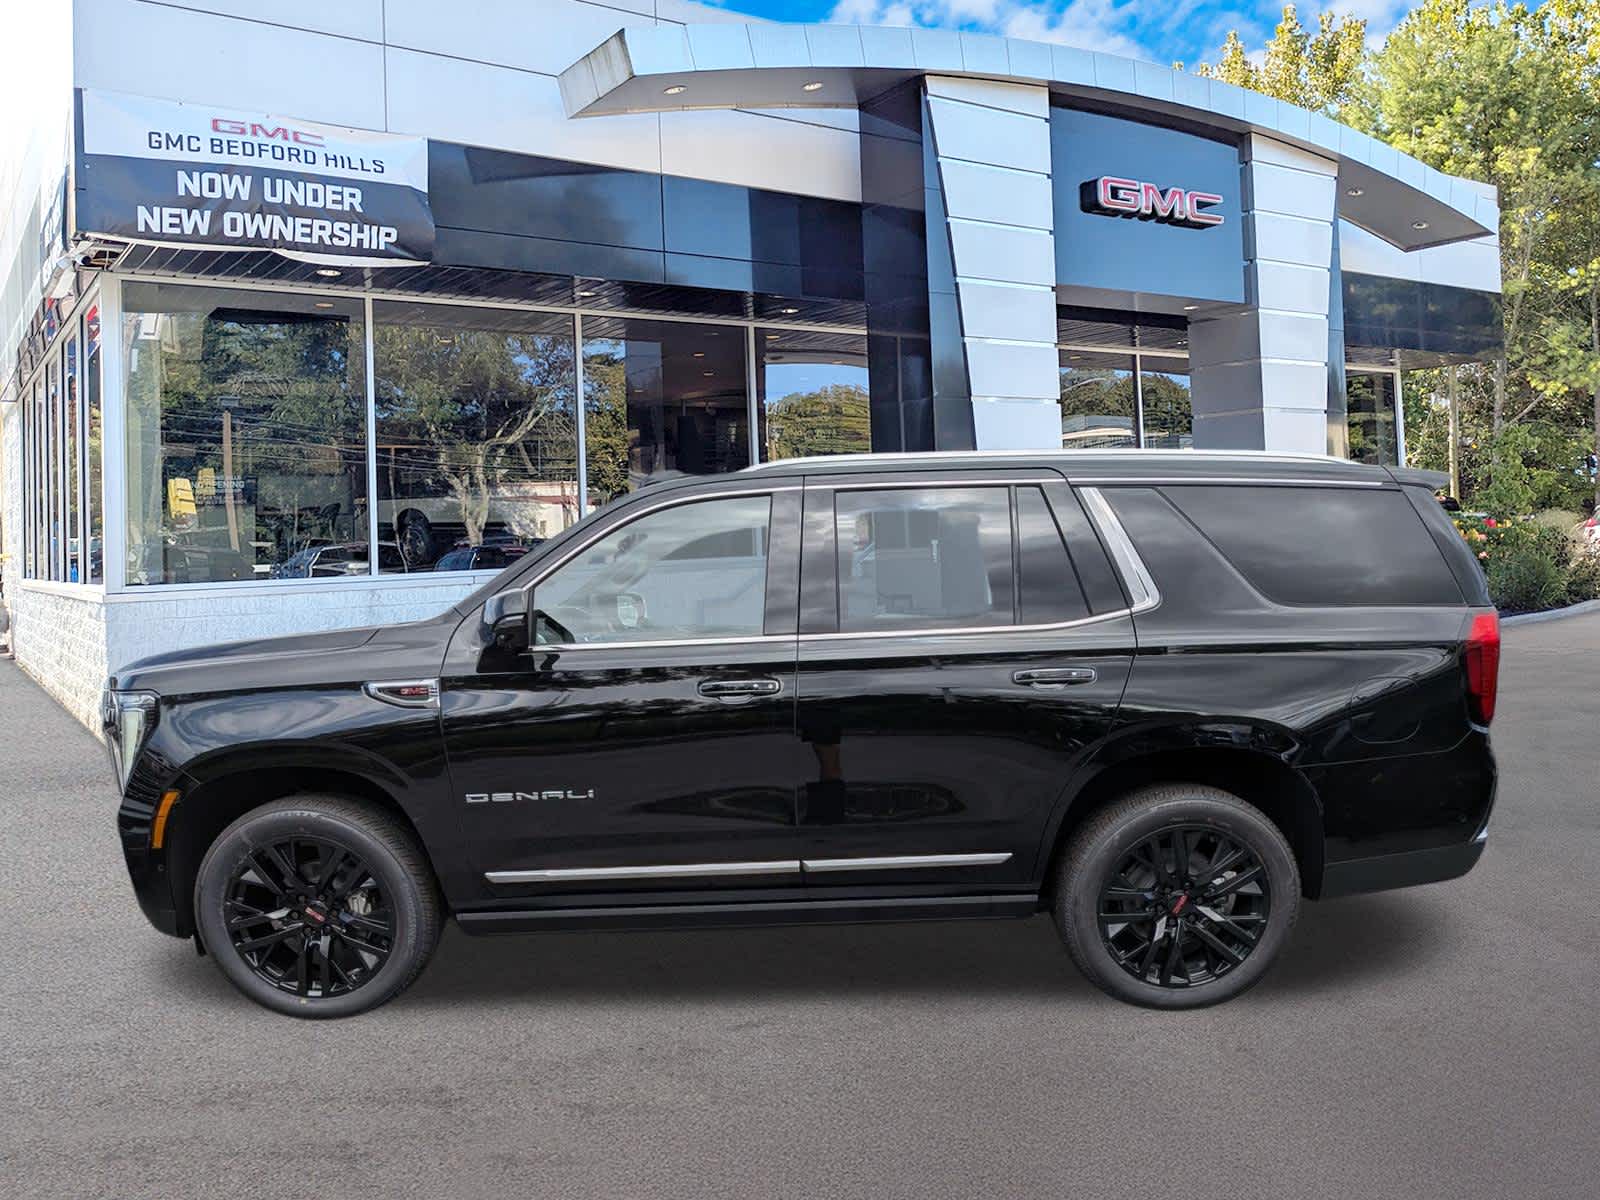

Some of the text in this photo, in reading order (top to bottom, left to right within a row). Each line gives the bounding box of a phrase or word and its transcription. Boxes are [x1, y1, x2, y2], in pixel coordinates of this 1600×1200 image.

[148, 131, 386, 174] GMC BEDFORD HILLS
[211, 118, 325, 148] GMC
[176, 170, 364, 213] NOW UNDER
[1097, 175, 1225, 225] GMC
[136, 205, 398, 250] NEW OWNERSHIP
[465, 788, 595, 804] DENALI
